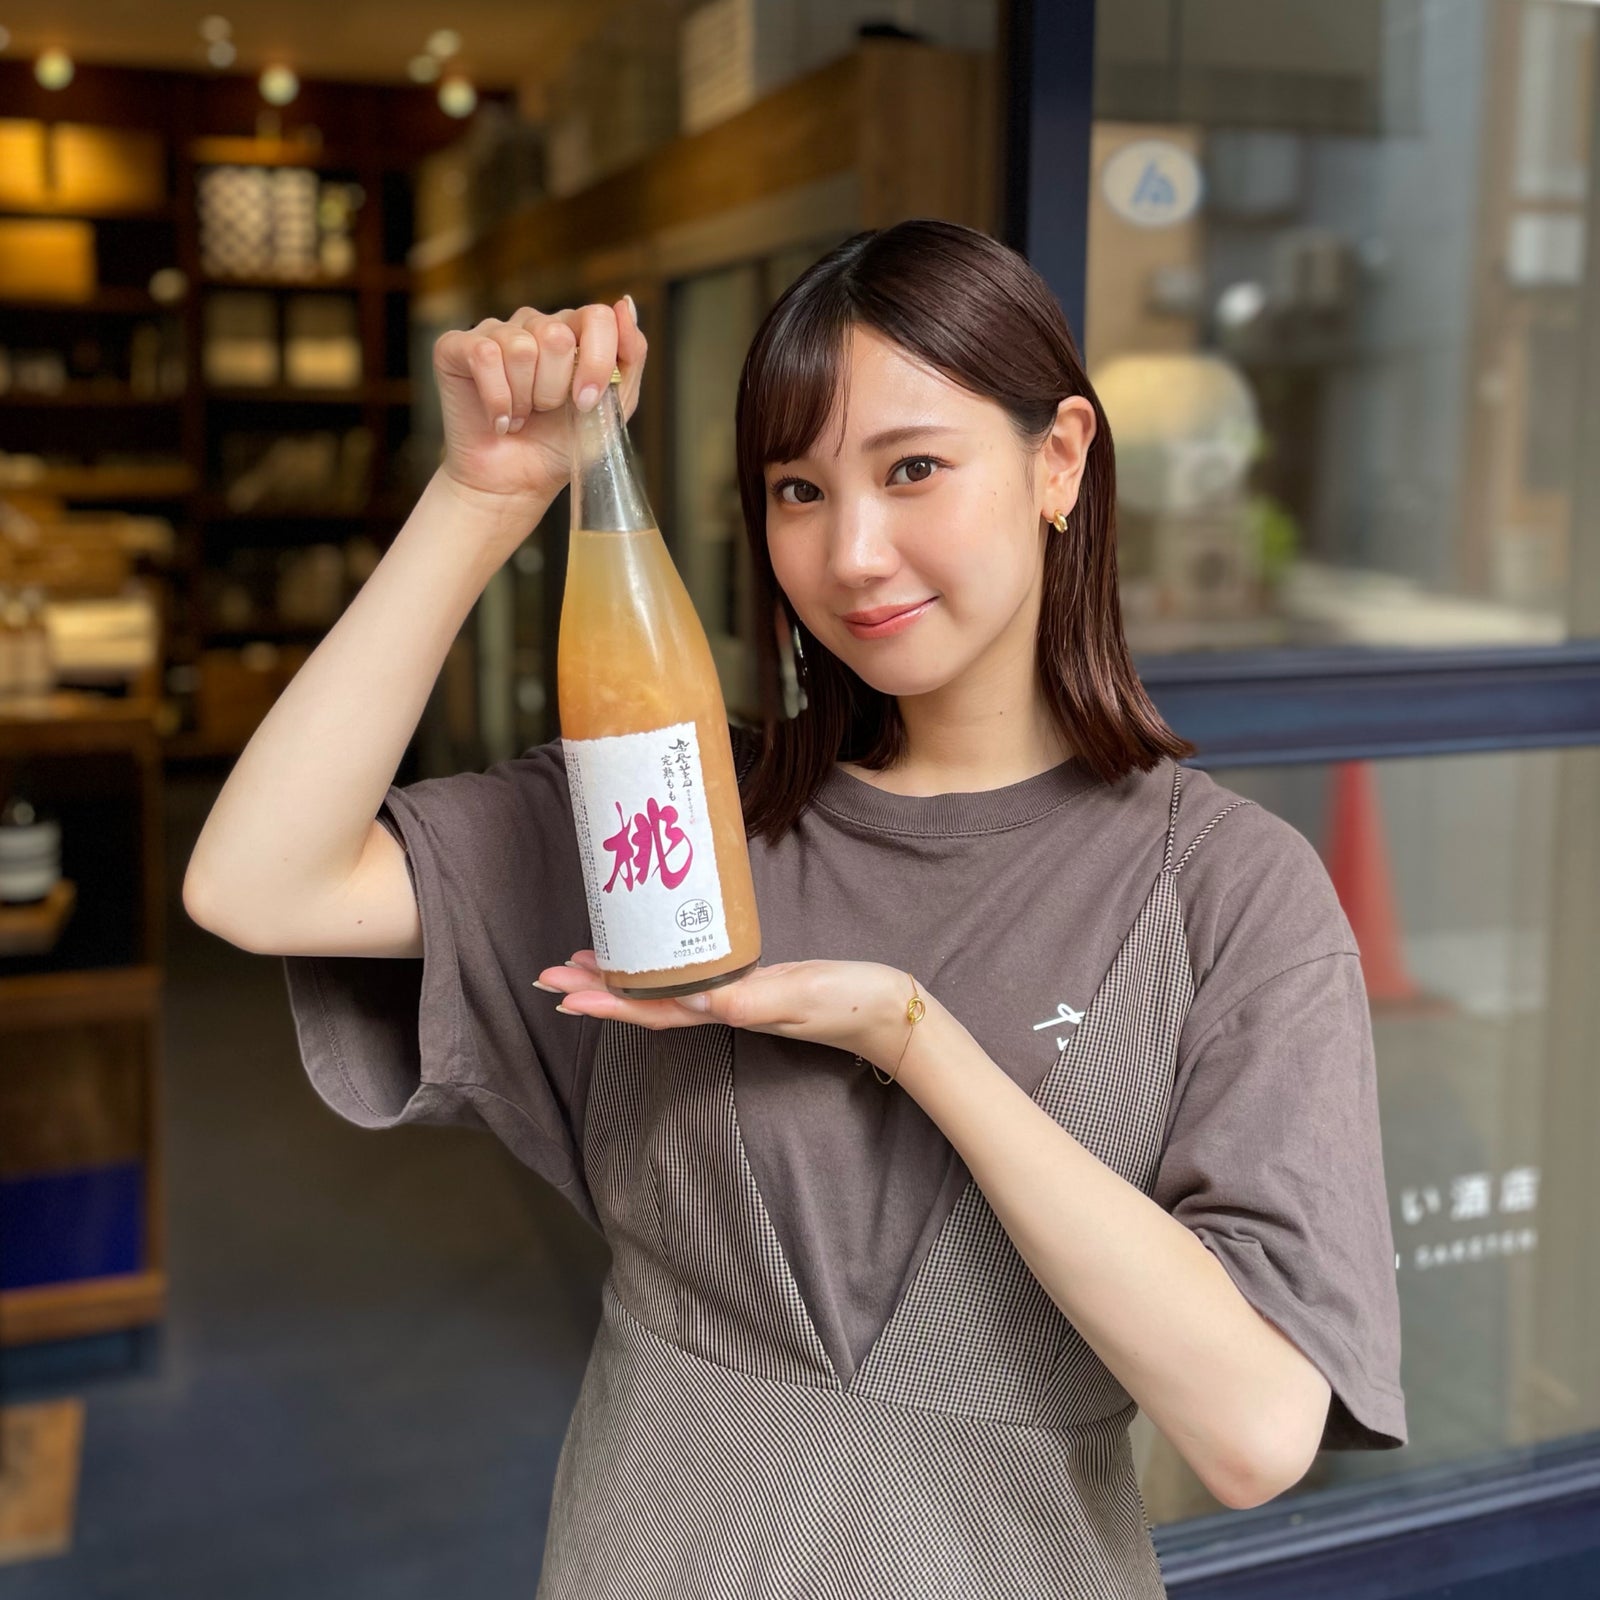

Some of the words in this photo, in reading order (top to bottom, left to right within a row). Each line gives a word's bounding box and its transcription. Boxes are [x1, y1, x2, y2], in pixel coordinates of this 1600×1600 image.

[661, 754, 676, 801] 完熟もも
[602, 797, 694, 893] 桃
[679, 905, 709, 927] お酒
[673, 943, 717, 958] 2023.06.16
